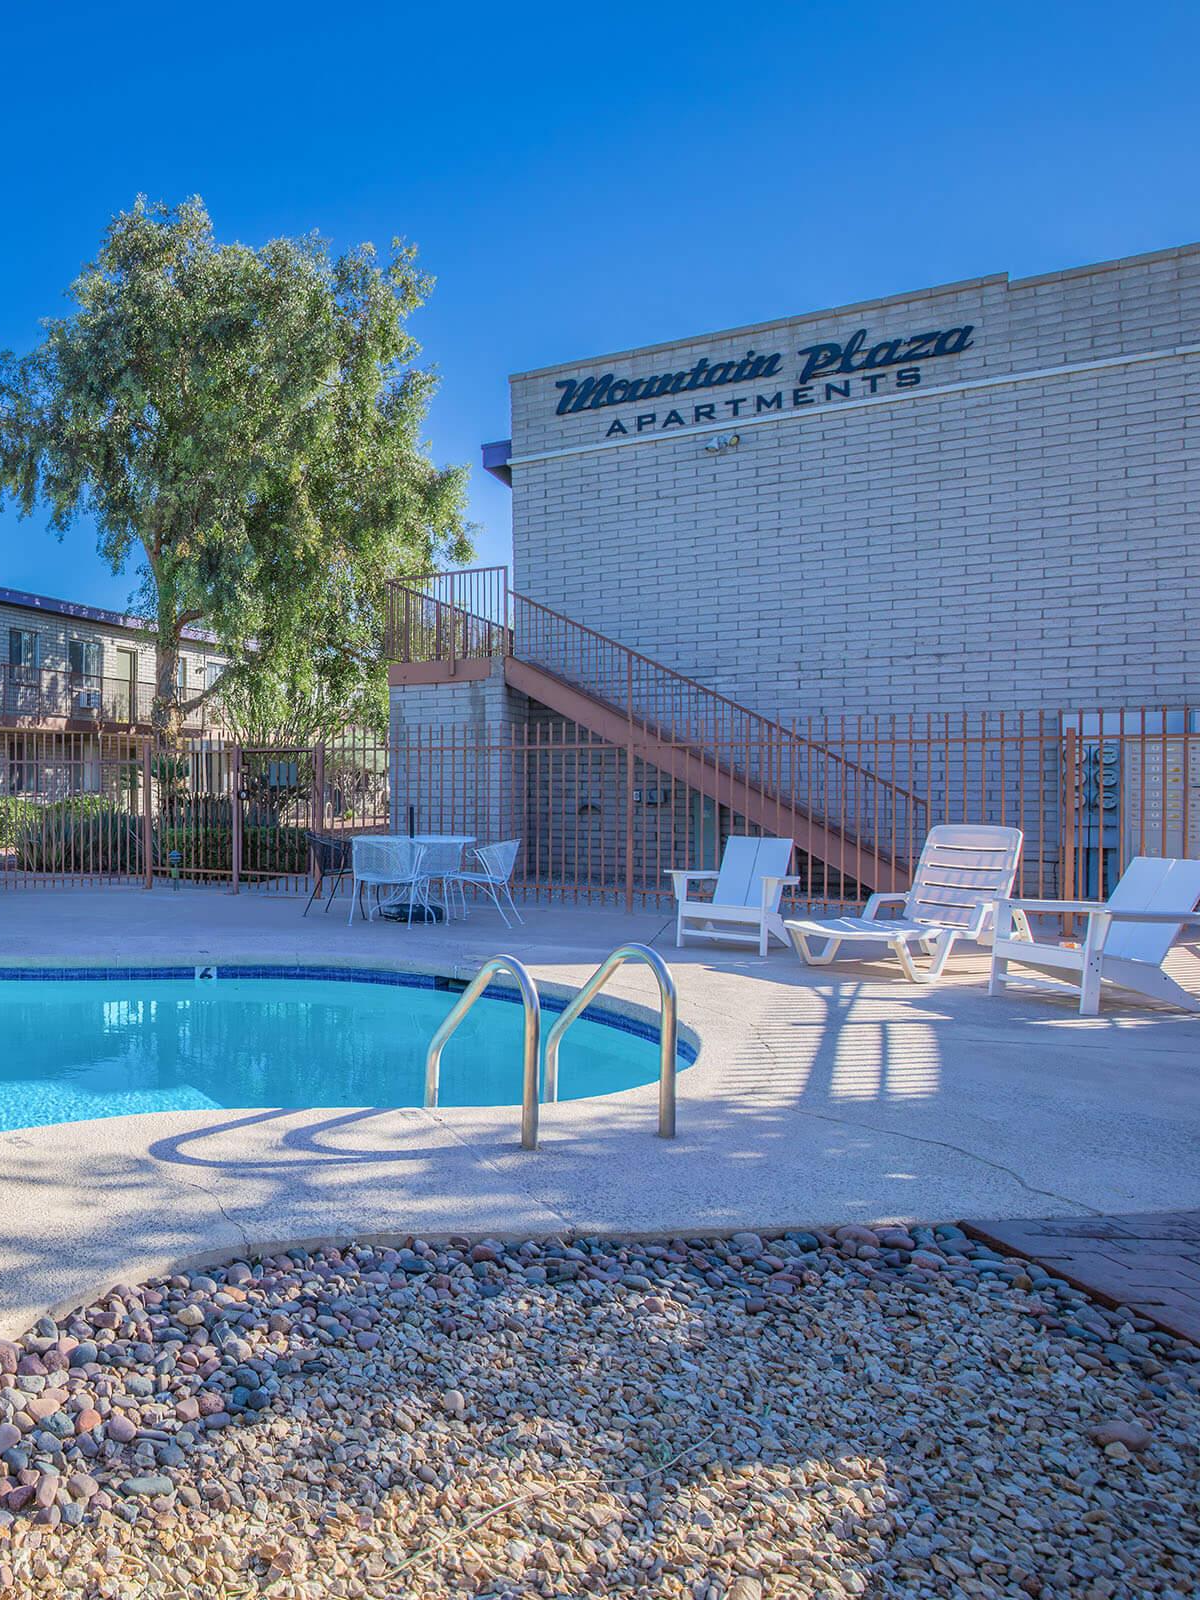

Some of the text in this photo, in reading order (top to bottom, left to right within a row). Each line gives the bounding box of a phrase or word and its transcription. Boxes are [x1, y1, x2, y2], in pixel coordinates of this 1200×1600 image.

[555, 325, 975, 415] Mountain Plaza
[605, 366, 921, 437] APARTMENTS
